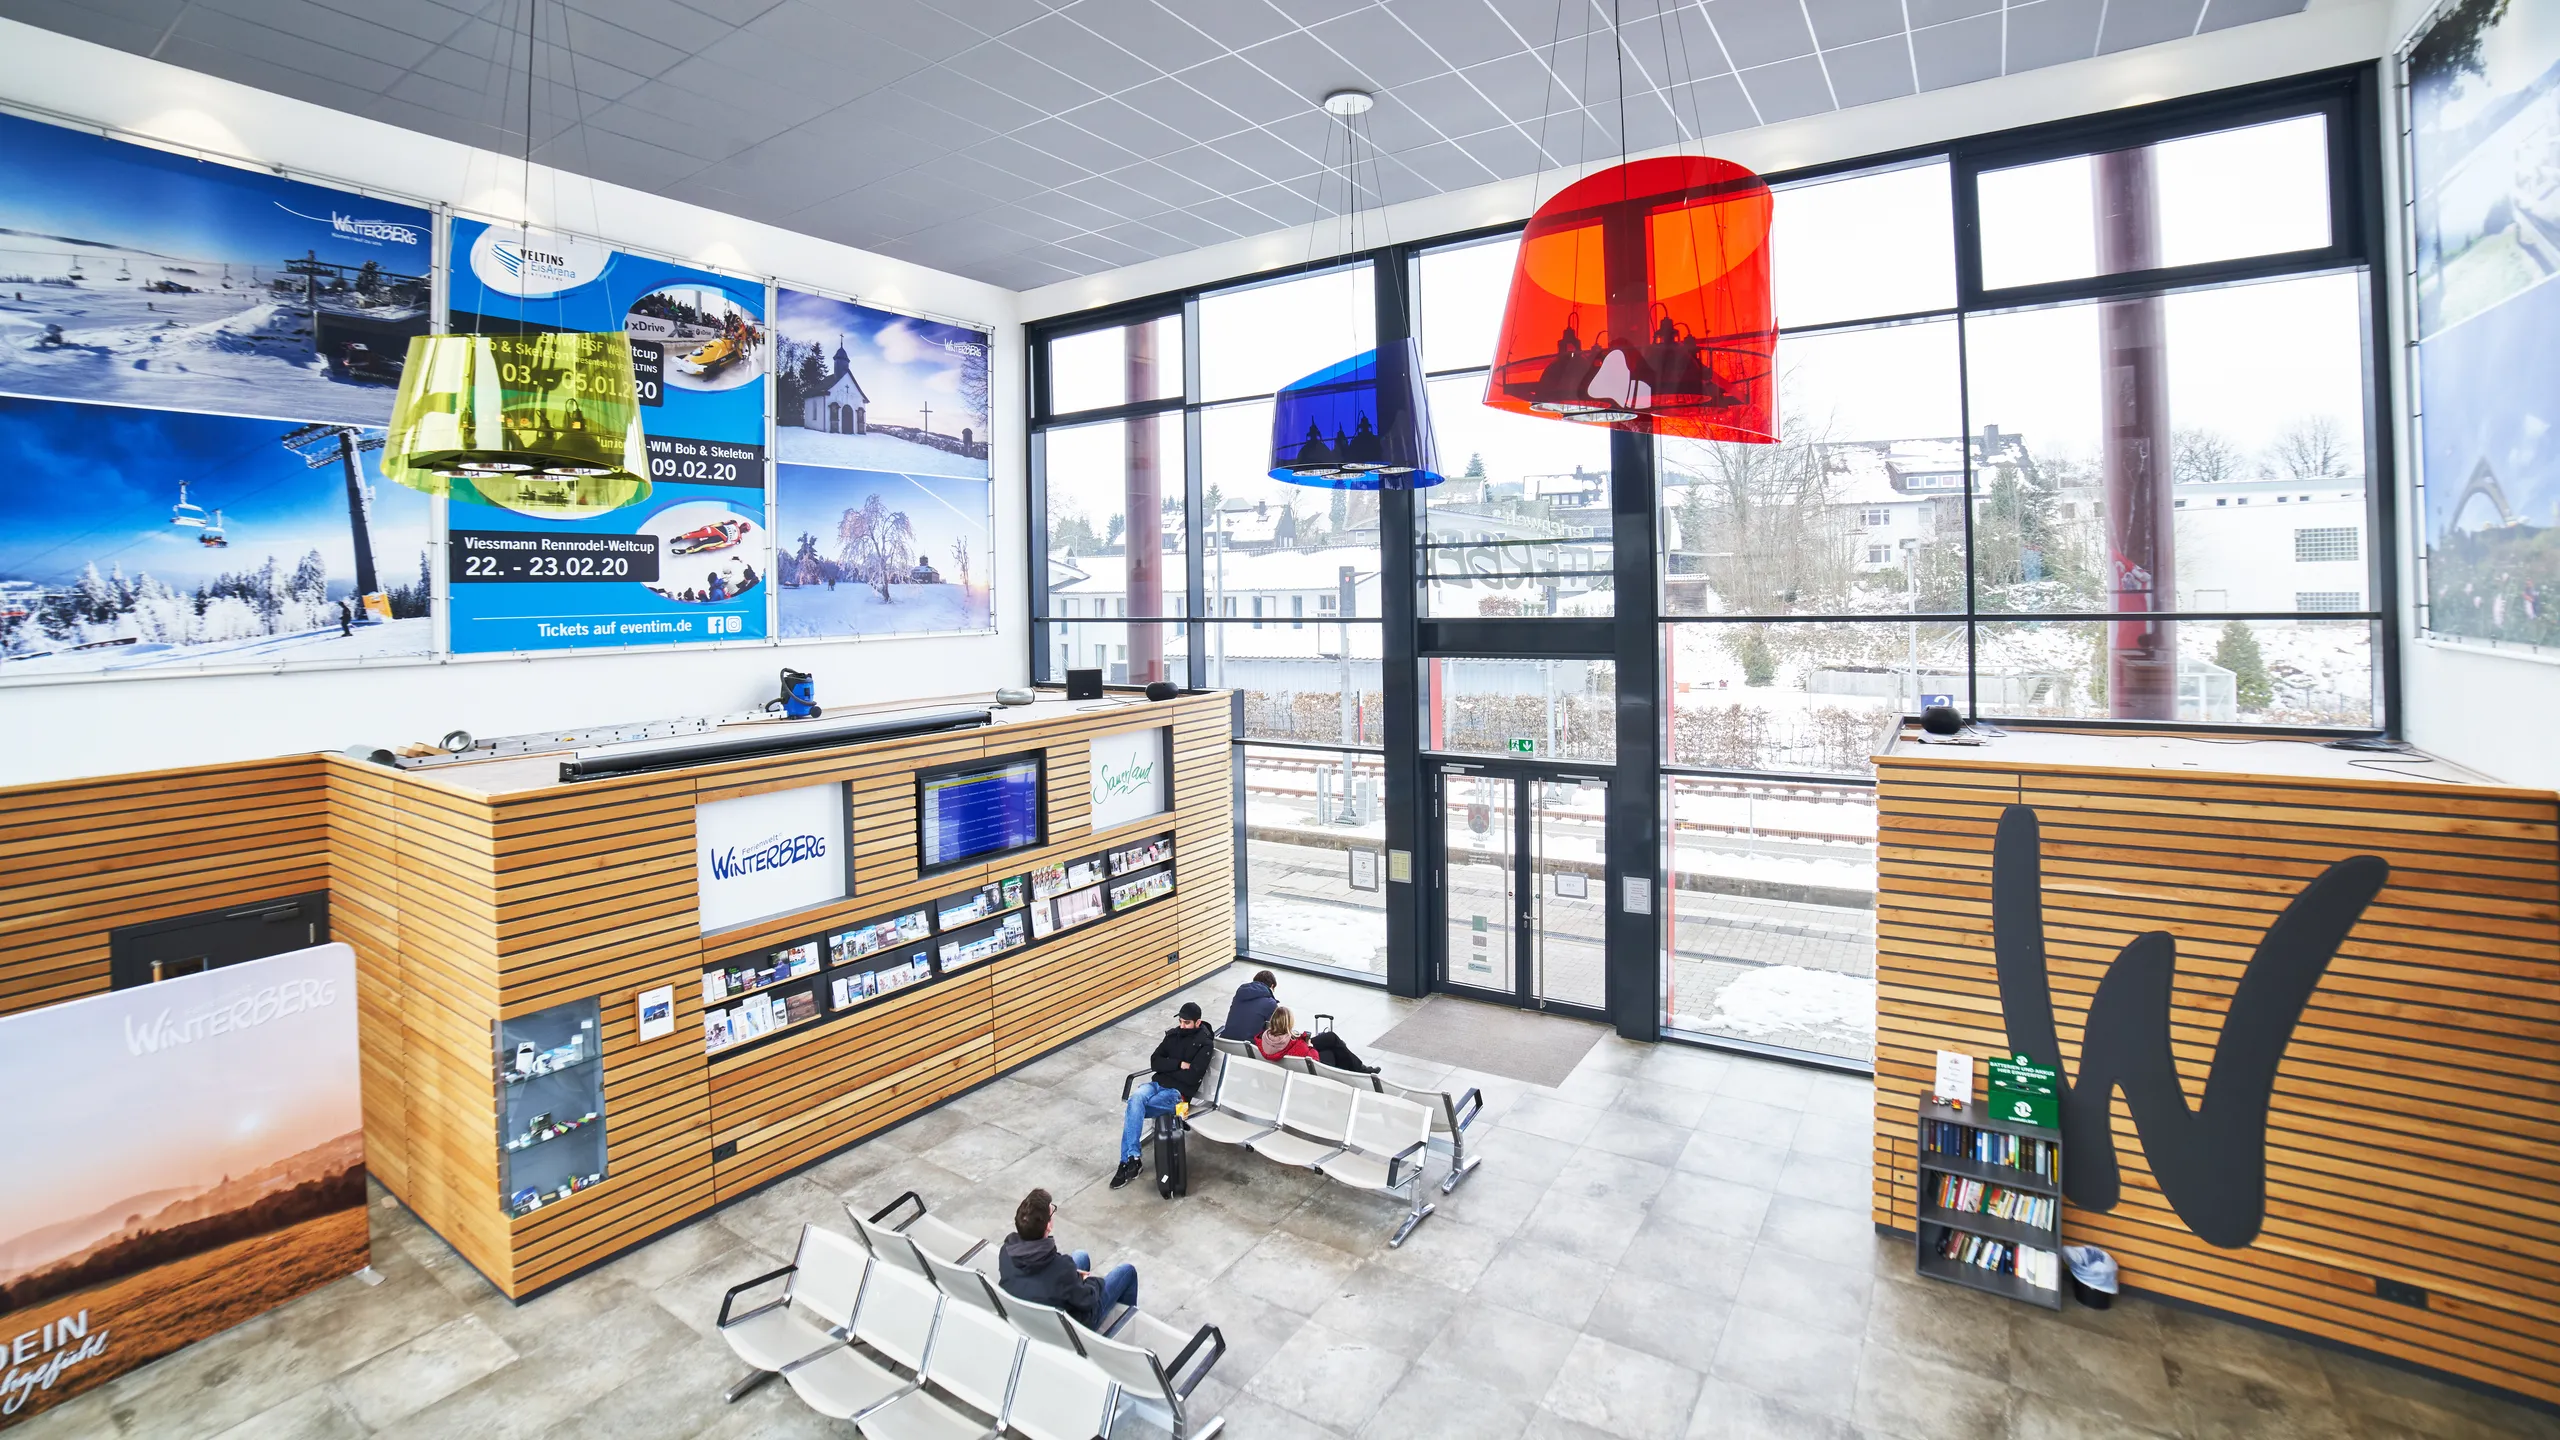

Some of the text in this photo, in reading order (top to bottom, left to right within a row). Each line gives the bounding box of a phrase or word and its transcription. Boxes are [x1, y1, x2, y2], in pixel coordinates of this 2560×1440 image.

[520, 248, 565, 267] VELTINS
[530, 261, 576, 279] EisArena
[631, 321, 665, 333] xDrive
[501, 340, 512, 353] &
[515, 343, 570, 362] Skeleton
[502, 362, 539, 386] 03.
[675, 443, 696, 455] Bob
[699, 446, 708, 457] &
[711, 447, 754, 461] Skeleton
[652, 458, 737, 481] 09.02.20
[464, 536, 655, 555] Viessmann Rennrodel-Weltcup
[465, 556, 505, 577] 22.
[528, 557, 629, 577] 23.02.20
[537, 620, 692, 638] Tickets auf eventim.de
[1093, 751, 1154, 804] Sauerland
[741, 833, 780, 856] Ferienwelt
[1989, 1061, 2021, 1071] BATTERIEN
